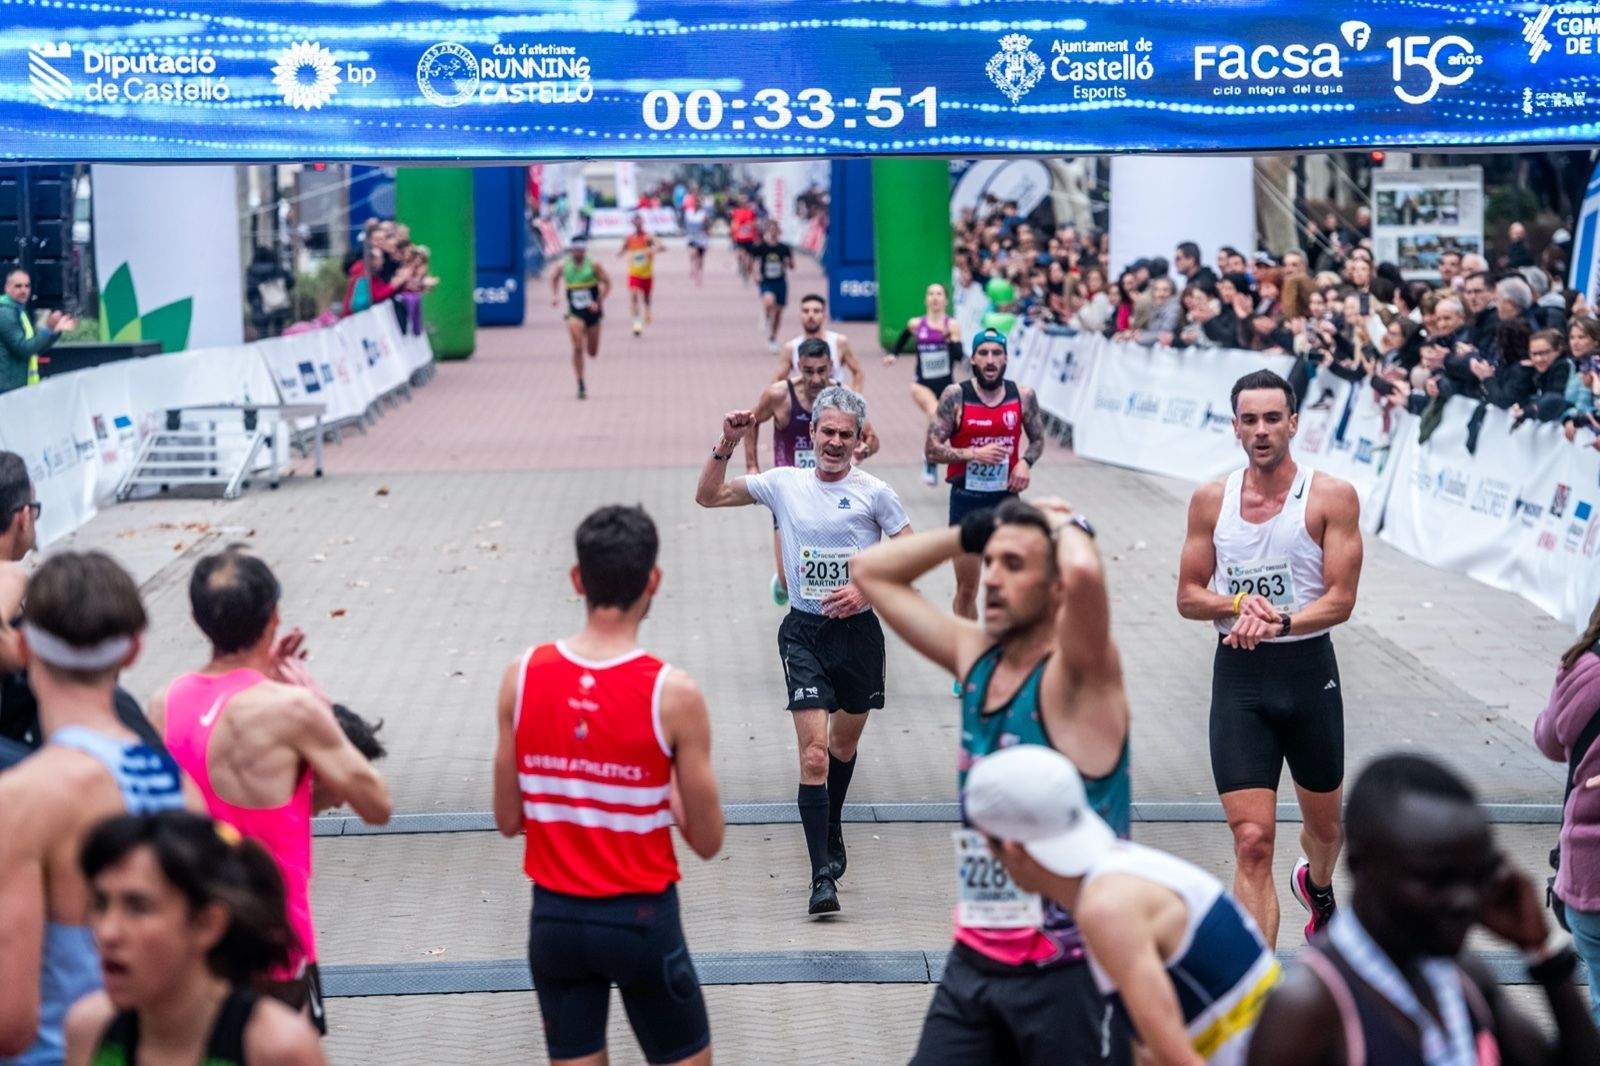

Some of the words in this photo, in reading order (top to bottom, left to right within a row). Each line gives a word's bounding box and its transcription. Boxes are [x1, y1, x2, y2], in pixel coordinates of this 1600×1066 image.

[493, 43, 515, 55] Club
[519, 43, 576, 55] d'atletisme
[1051, 39, 1128, 55] Ajuntament
[1135, 37, 1153, 52] de
[1566, 37, 1592, 54] DE
[83, 49, 216, 78] Diputació
[481, 57, 591, 80] RUNNING
[1051, 55, 1153, 81] Castelló
[1447, 53, 1484, 66] años
[347, 63, 376, 86] bp
[84, 77, 118, 101] de
[123, 76, 230, 102] Castelló
[1073, 85, 1126, 100] Esports
[1213, 85, 1241, 96] ciclo
[1292, 84, 1311, 95] del
[642, 87, 938, 131] 00:33:51
[972, 463, 1004, 477] 2227
[805, 560, 850, 580] 2031
[808, 579, 836, 587] MARTIN
[1231, 574, 1285, 599] 2263
[965, 856, 1008, 889] 228
